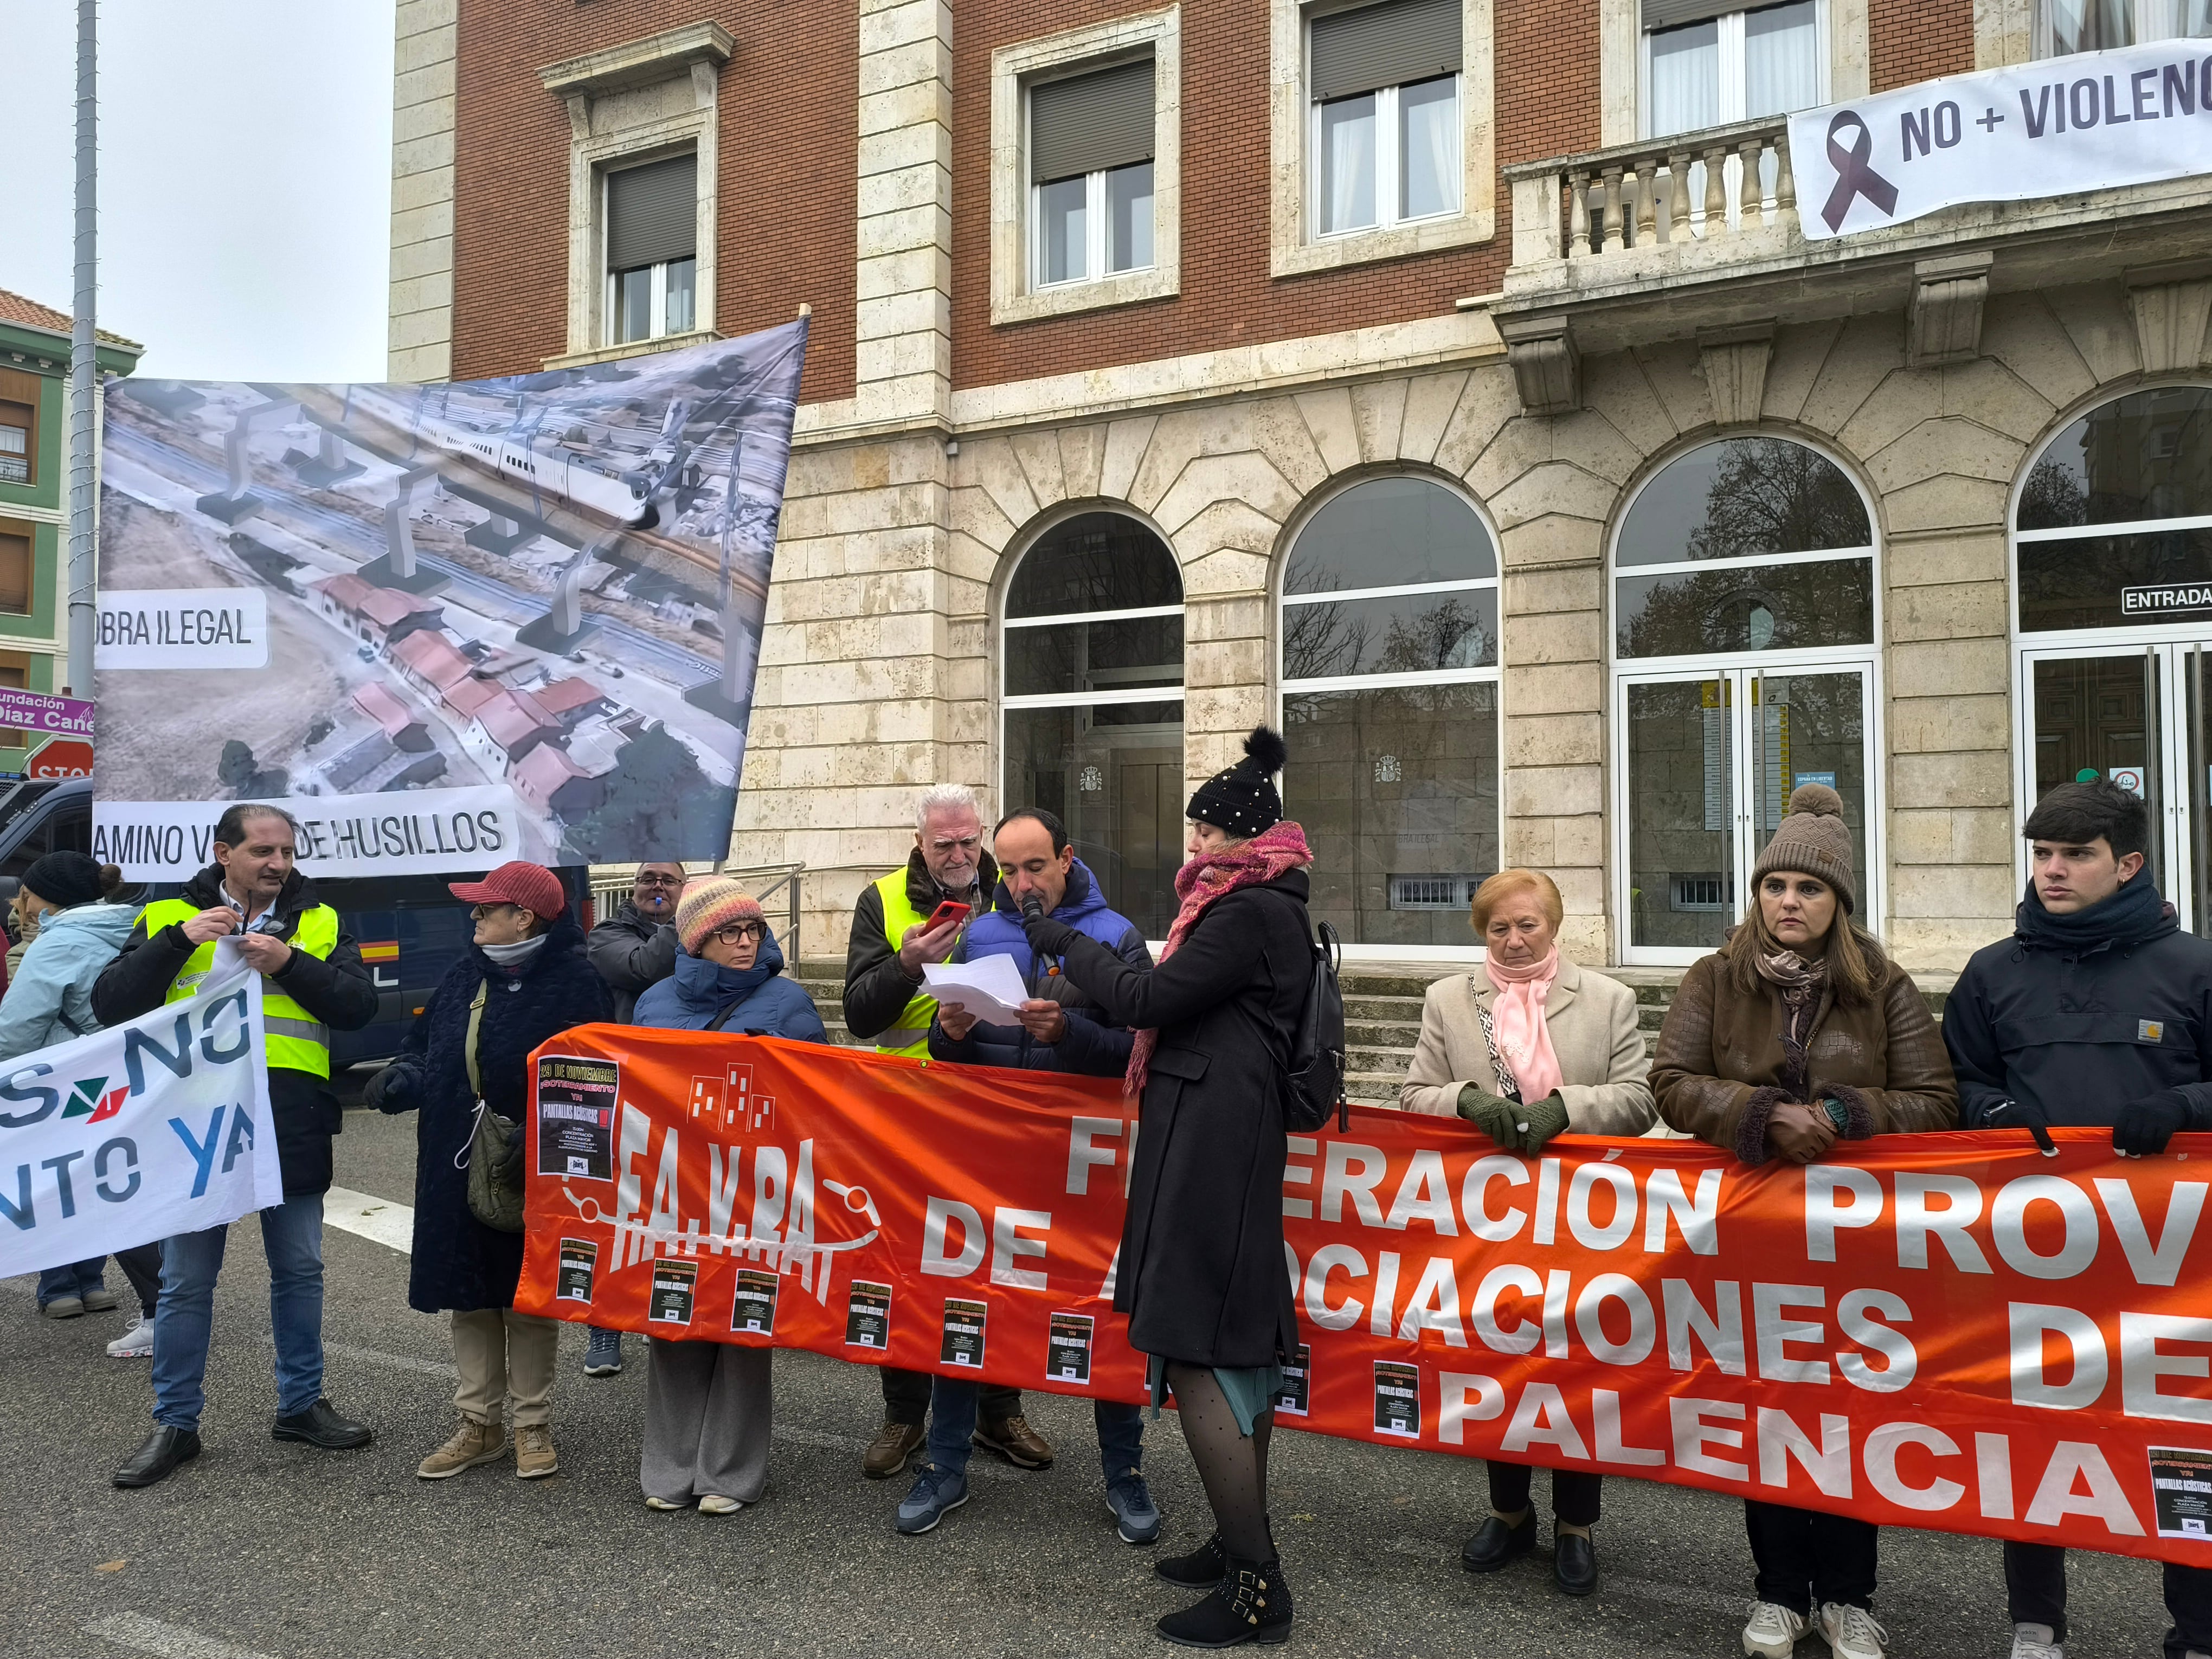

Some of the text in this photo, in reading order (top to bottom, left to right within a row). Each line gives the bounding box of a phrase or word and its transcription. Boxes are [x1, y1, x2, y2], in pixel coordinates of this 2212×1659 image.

[1901, 101, 1961, 162] NO
[2126, 588, 2212, 608] ENTRADA
[157, 608, 252, 645] ILEGAL
[293, 820, 327, 860] DE
[331, 810, 503, 859] HUSILLOS
[541, 1064, 616, 1083] 29 DE NOVIEMBRE
[543, 1104, 608, 1125] PANTALLAS ACÚSTICAS NO
[168, 1102, 254, 1200] YA
[1066, 1115, 2209, 1285] FERACIÓN PROV
[920, 1195, 2212, 1422] DE CIACIONES DE
[1438, 1369, 2146, 1536] PALENCIA
[2155, 1478, 2183, 1490] PANTALLAS
